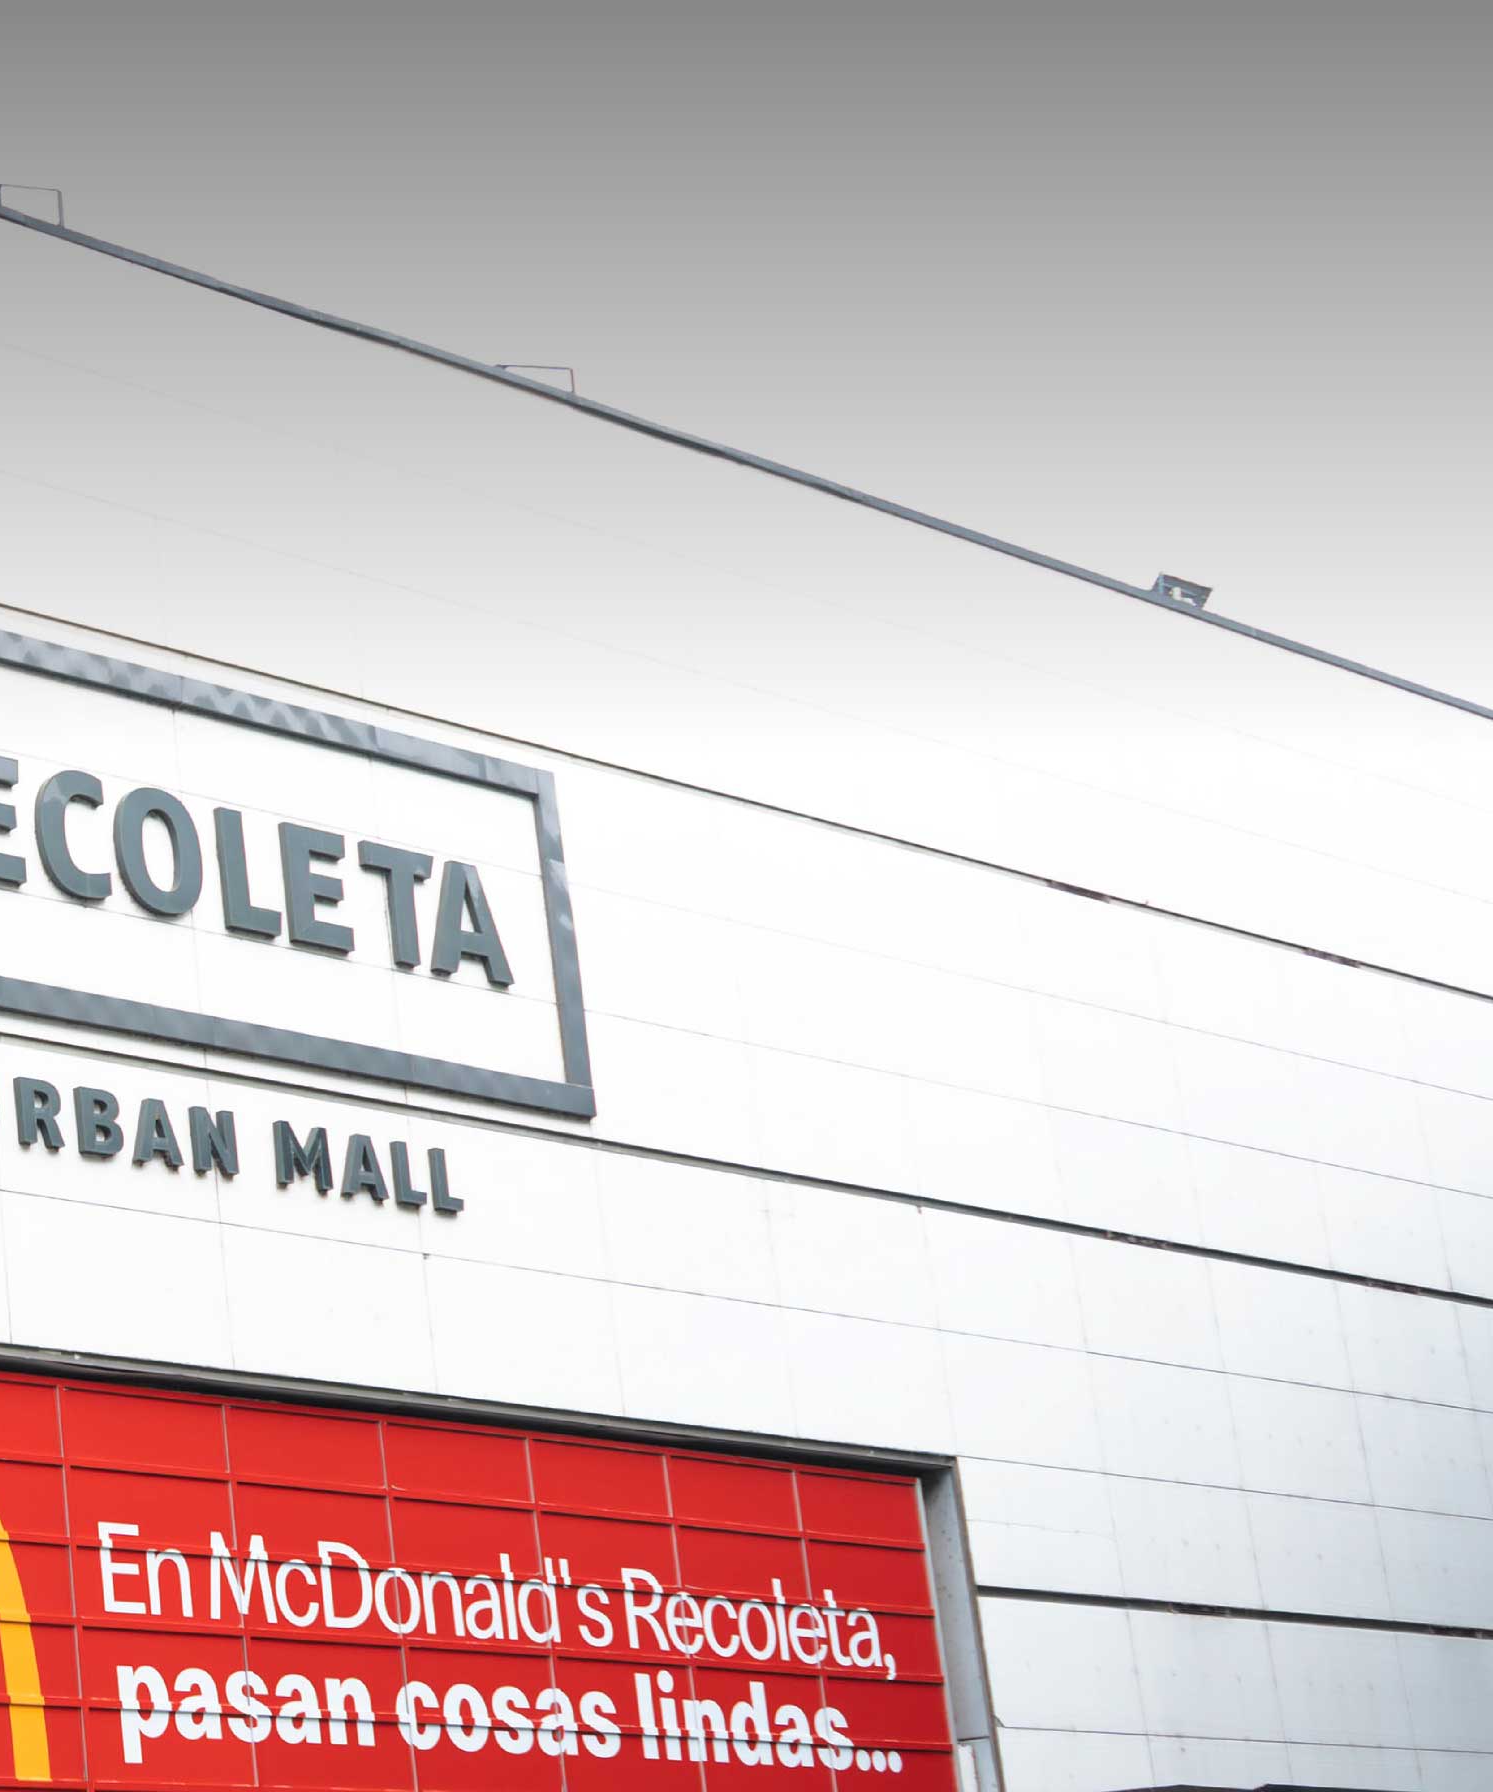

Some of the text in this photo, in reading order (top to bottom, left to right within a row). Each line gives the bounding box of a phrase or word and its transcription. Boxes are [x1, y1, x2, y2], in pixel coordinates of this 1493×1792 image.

[273, 1120, 464, 1214] MALL
[98, 1521, 897, 1680] En McDonald's Recoleta,
[116, 1665, 903, 1773] pasan cosas lindas...
